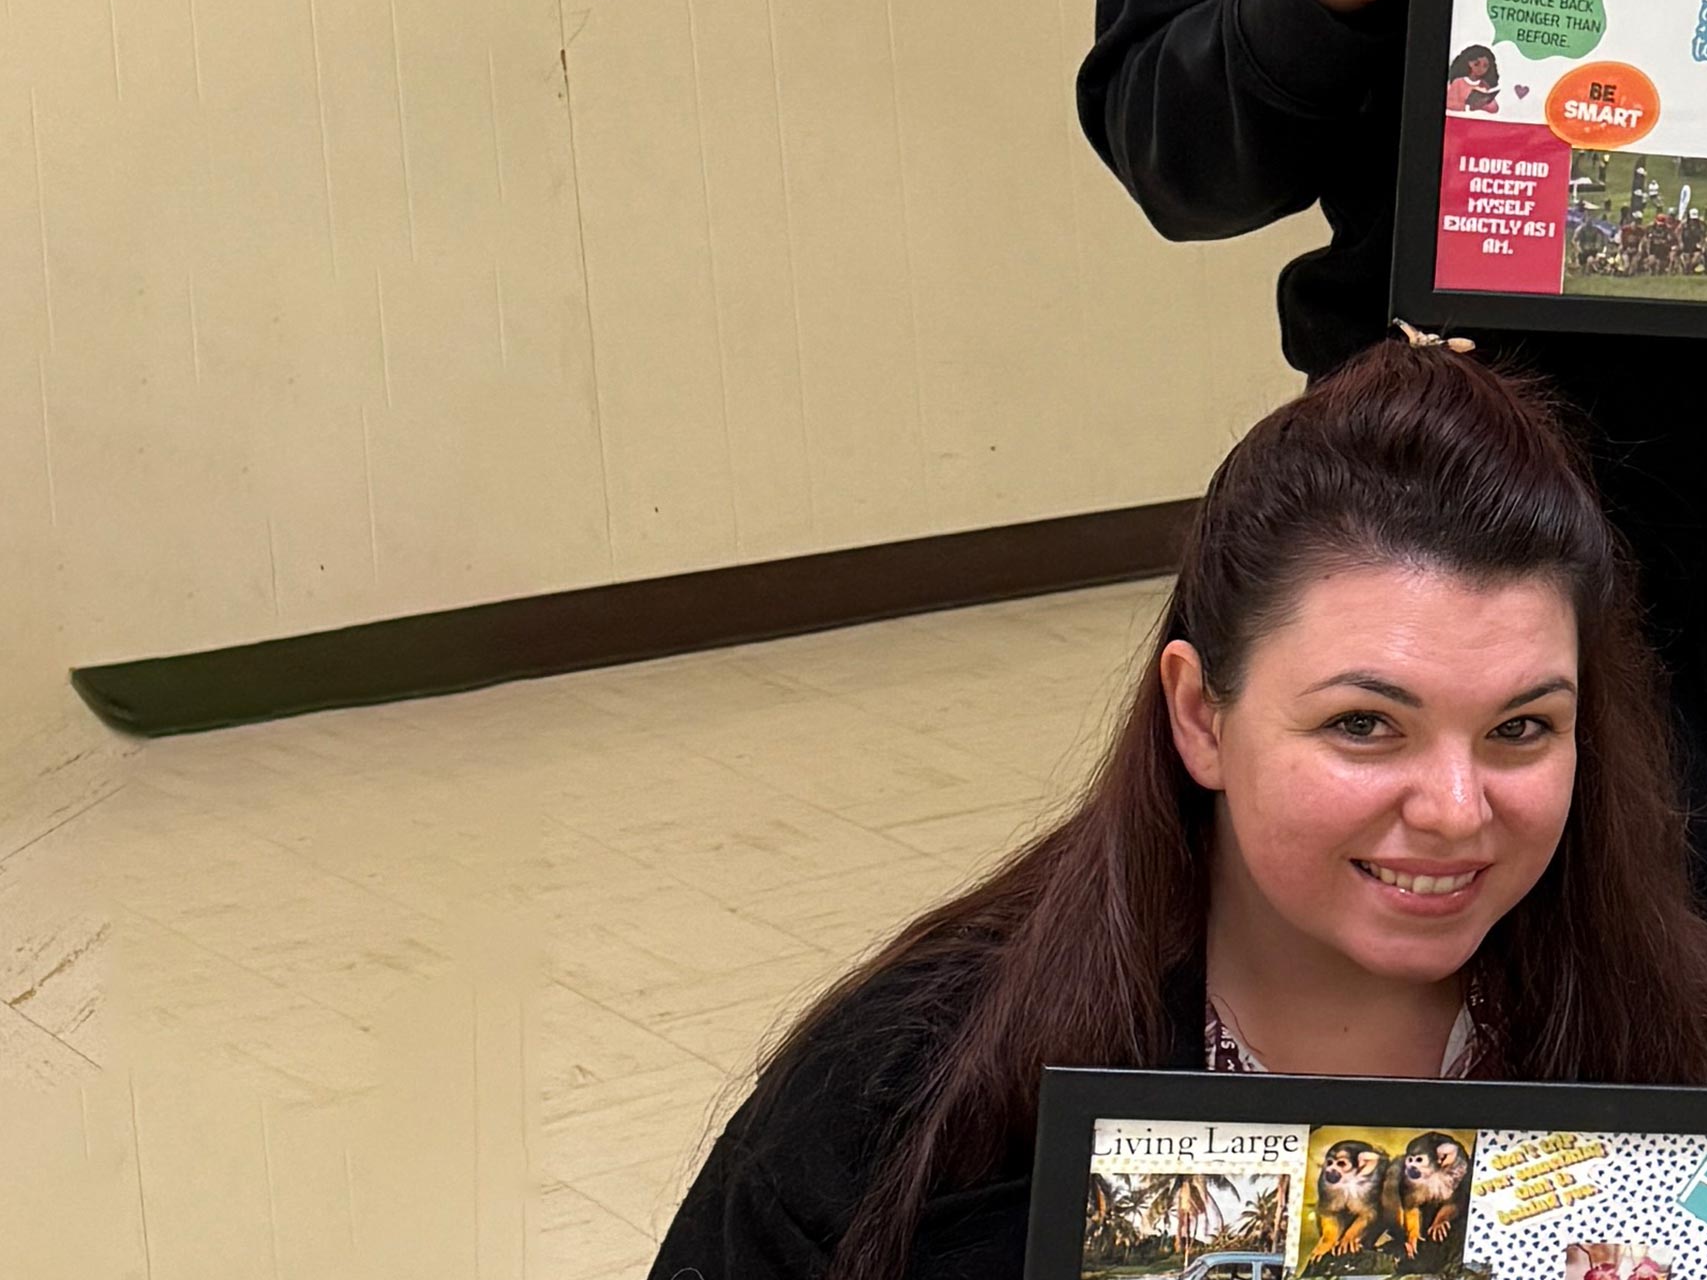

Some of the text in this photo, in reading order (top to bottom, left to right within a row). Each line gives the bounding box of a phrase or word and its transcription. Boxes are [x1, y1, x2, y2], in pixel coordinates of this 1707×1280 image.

[1490, 6, 1600, 34] STRONGER THAN
[1517, 29, 1570, 48] BEFORE.
[1590, 82, 1617, 102] BE
[1564, 100, 1643, 128] SMART
[1460, 156, 1549, 178] I LOVE AND
[1469, 177, 1537, 196] ACCEPT
[1468, 198, 1535, 216] MYSELF
[1444, 215, 1555, 237] EXACTLY AS I
[1482, 239, 1513, 254] AM.
[1094, 1126, 1299, 1162] Living Large
